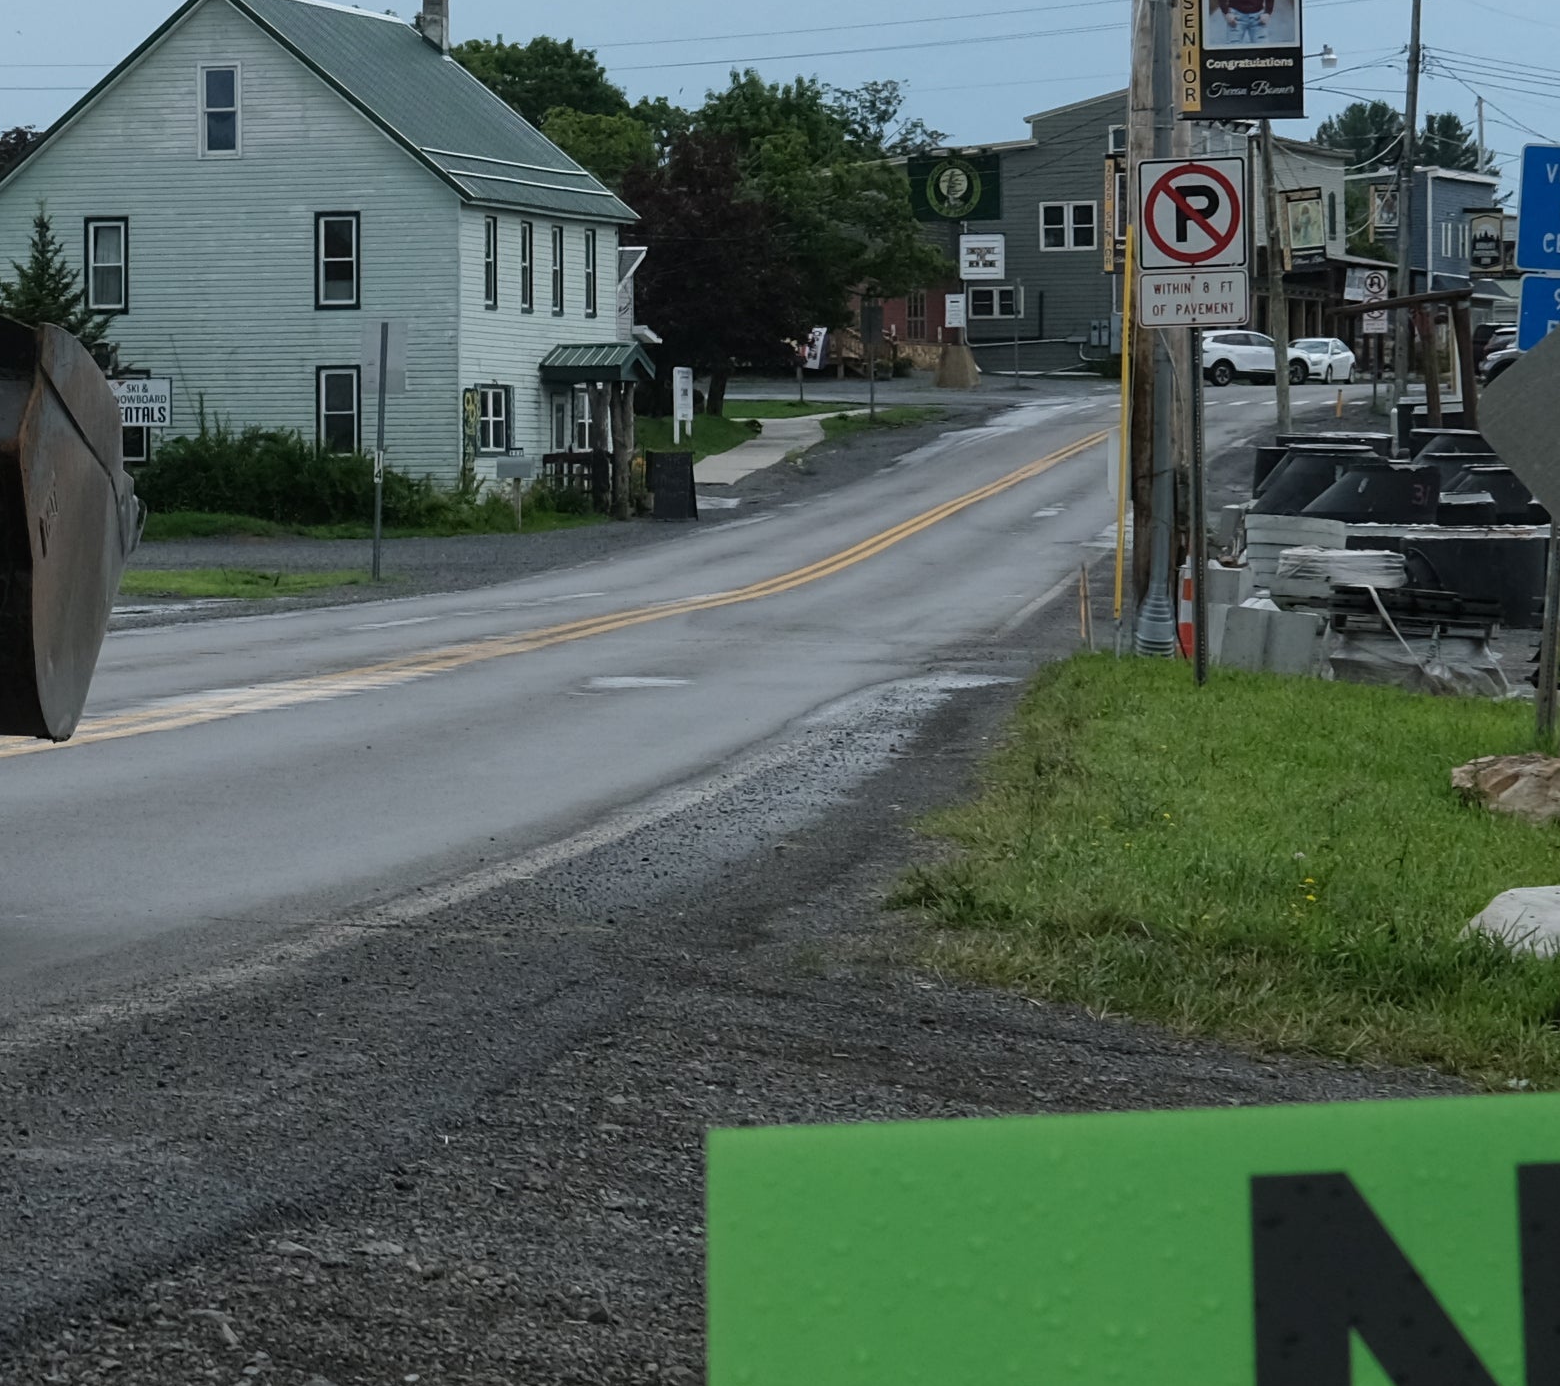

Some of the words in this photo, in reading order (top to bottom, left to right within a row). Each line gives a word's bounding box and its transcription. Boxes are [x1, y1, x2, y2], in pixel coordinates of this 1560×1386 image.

[1206, 57, 1294, 71] Congratulations
[1153, 282, 1191, 296] WITHIN
[1203, 282, 1210, 294] 8
[1220, 281, 1233, 293] FT
[1152, 304, 1166, 316] OF
[1176, 302, 1234, 315] PAVEMENT
[126, 383, 140, 394] SKI
[141, 383, 149, 393] &
